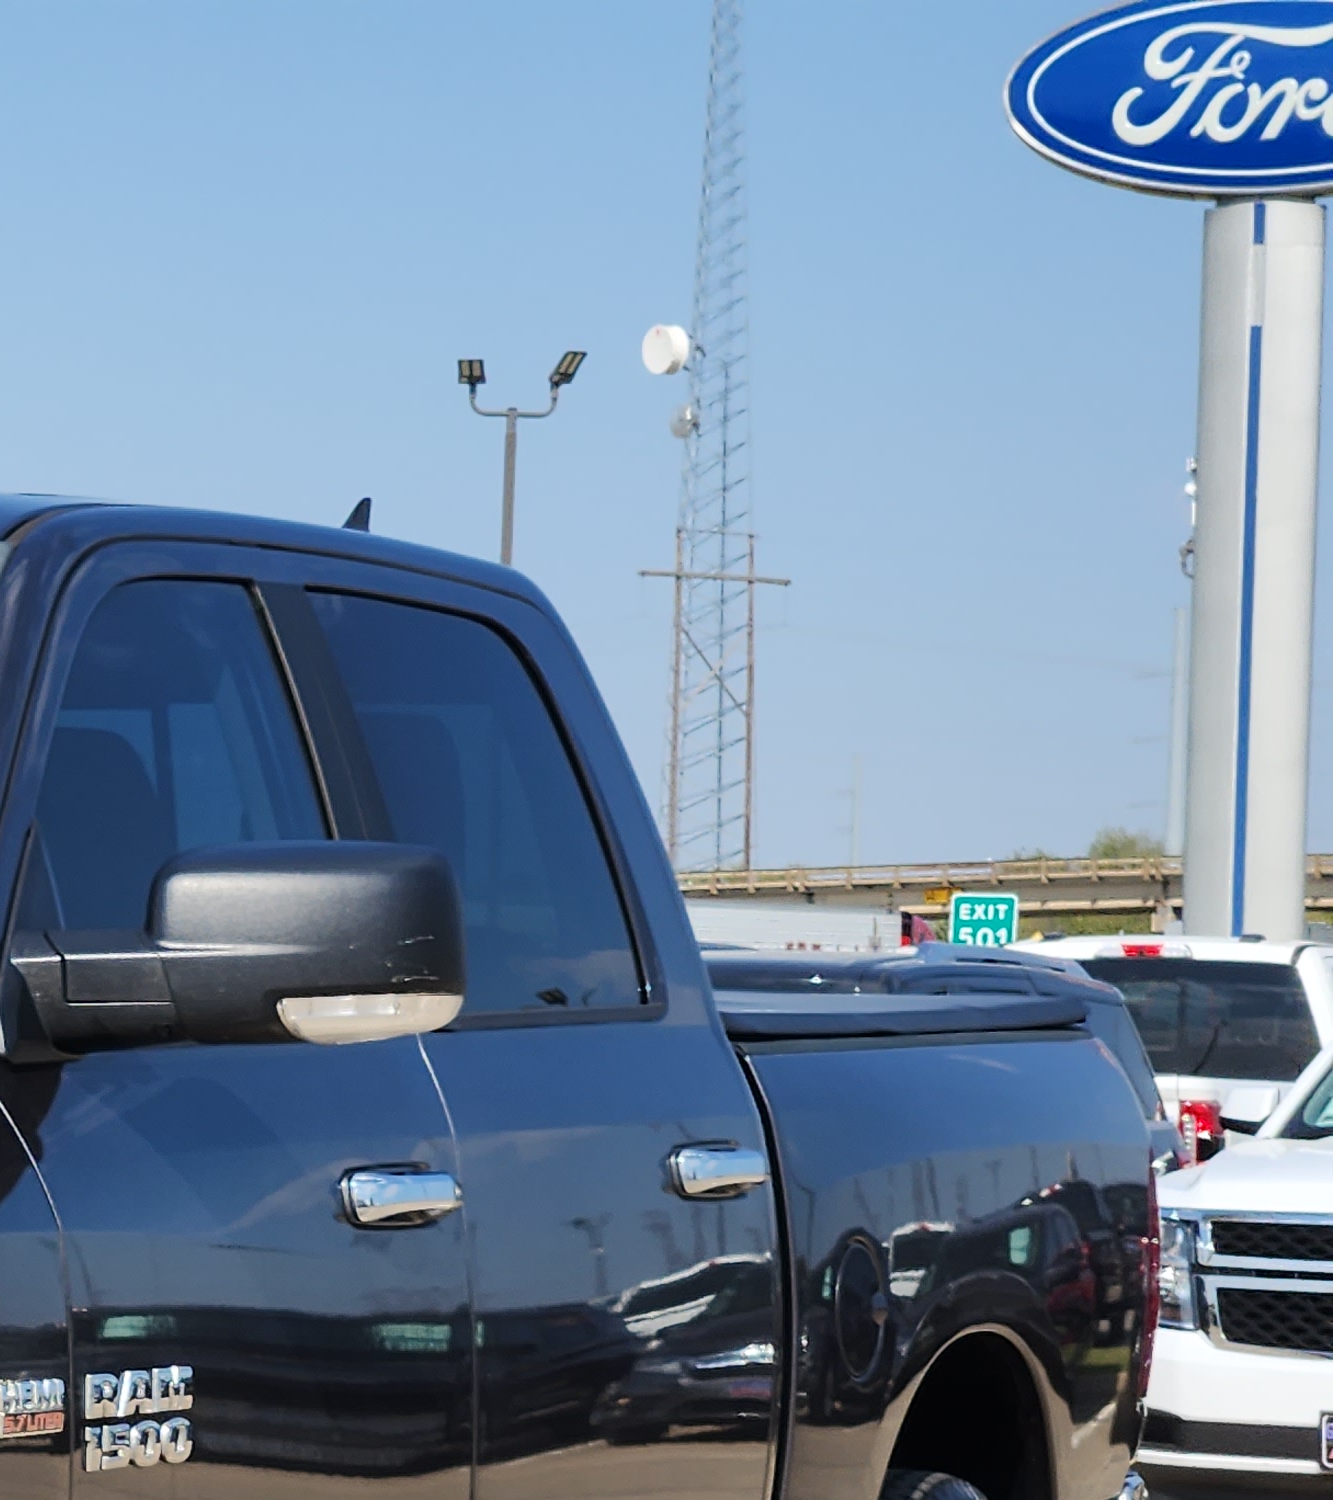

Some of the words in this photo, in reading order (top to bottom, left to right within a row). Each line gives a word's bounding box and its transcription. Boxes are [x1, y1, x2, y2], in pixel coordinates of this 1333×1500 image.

[1112, 22, 1333, 147] For
[959, 903, 1009, 921] EXIT
[958, 926, 1008, 945] 501
[84, 1364, 194, 1420] RAM
[27, 1412, 64, 1431] LITER
[84, 1416, 194, 1473] 1500
